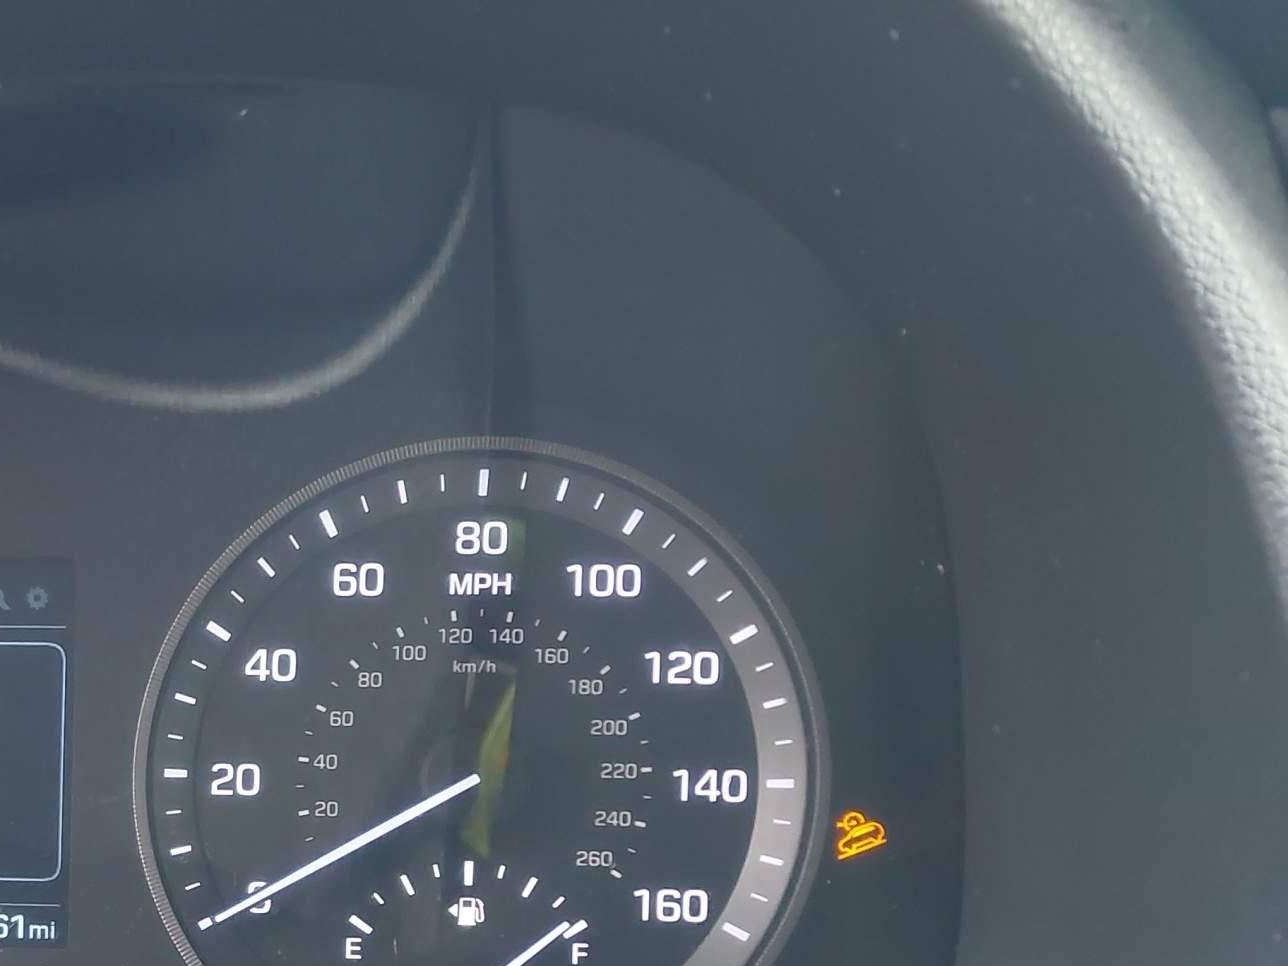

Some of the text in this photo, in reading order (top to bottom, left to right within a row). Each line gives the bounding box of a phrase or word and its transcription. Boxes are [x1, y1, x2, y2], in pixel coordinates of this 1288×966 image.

[455, 520, 508, 555] 80
[332, 562, 385, 597] 60
[448, 572, 513, 596] MPH
[566, 563, 642, 598] 100
[438, 628, 473, 644] 120
[488, 628, 524, 645] 140
[392, 645, 427, 661] 100
[534, 648, 569, 664] 160
[244, 648, 297, 682] 40
[452, 659, 497, 673] km/h
[644, 650, 720, 686] 120
[357, 671, 383, 688] 80
[568, 679, 604, 695] 180
[329, 710, 354, 727] 60
[590, 719, 628, 736] 200
[313, 753, 338, 770] 40
[600, 762, 638, 779] 220
[210, 763, 261, 797] 20
[672, 768, 748, 804] 140
[314, 801, 339, 817] 20
[594, 810, 632, 827] 240
[575, 850, 613, 867] 260
[633, 888, 709, 924] 160
[344, 937, 363, 960] E
[571, 942, 589, 965] F
